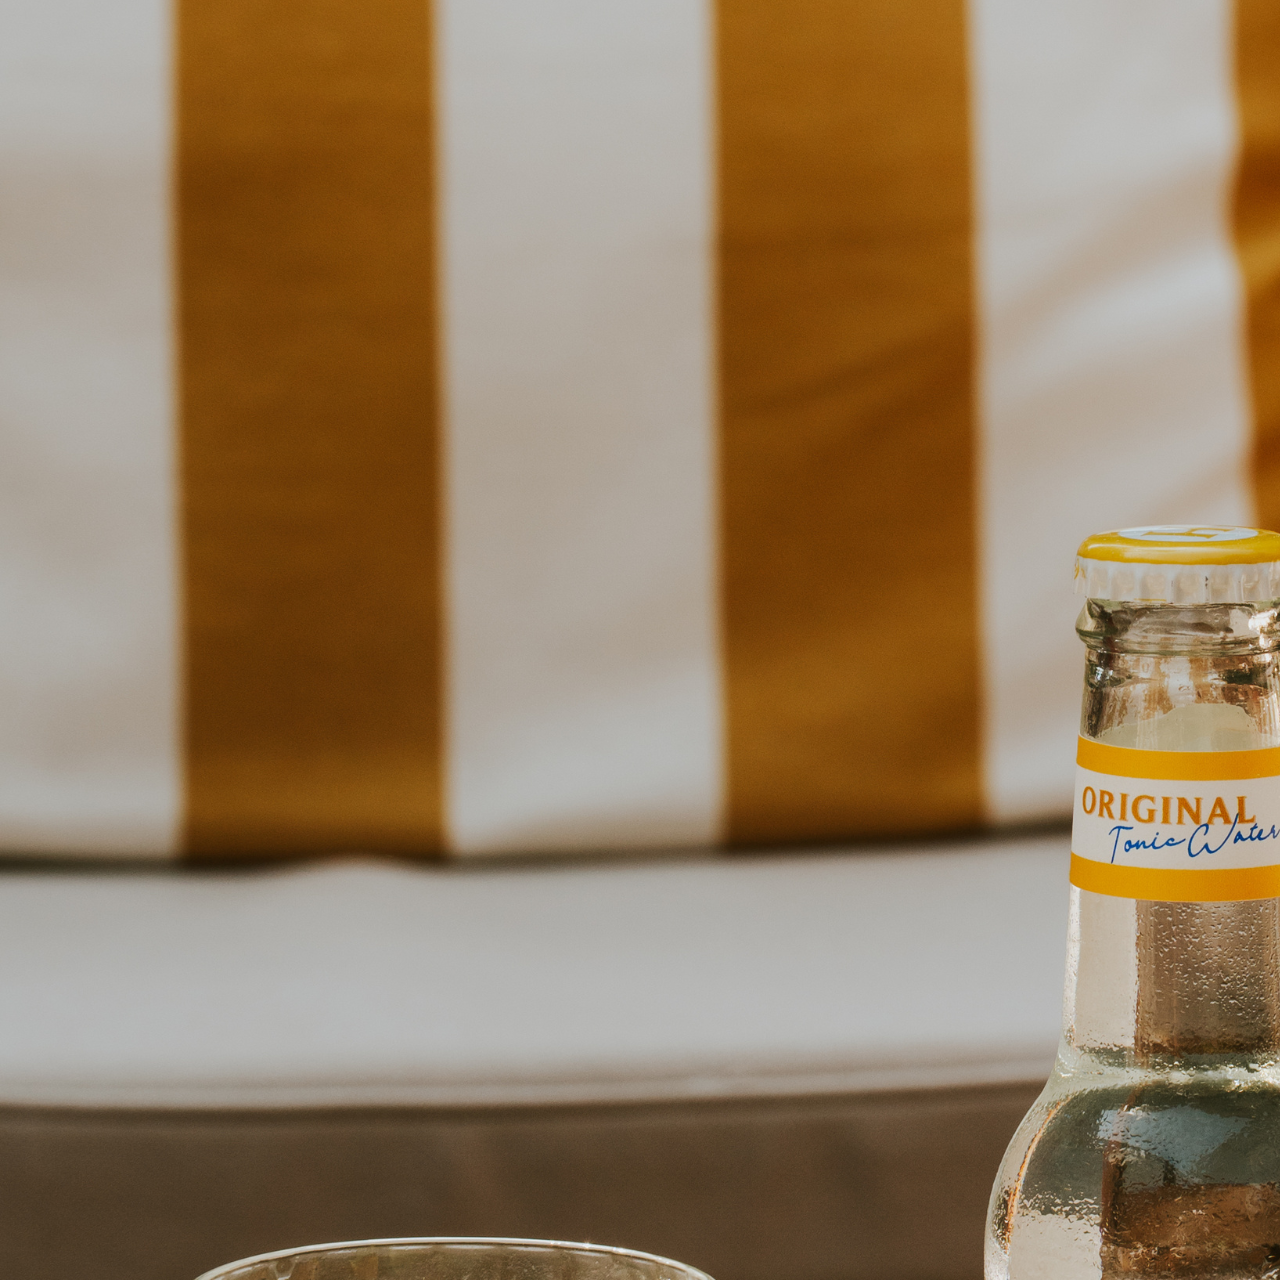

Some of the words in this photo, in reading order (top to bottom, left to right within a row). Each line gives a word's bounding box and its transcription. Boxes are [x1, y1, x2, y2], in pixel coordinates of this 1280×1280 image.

[1082, 786, 1256, 826] ORIGINAL
[1109, 825, 1187, 864] Tonic
[1187, 813, 1280, 858] Water
